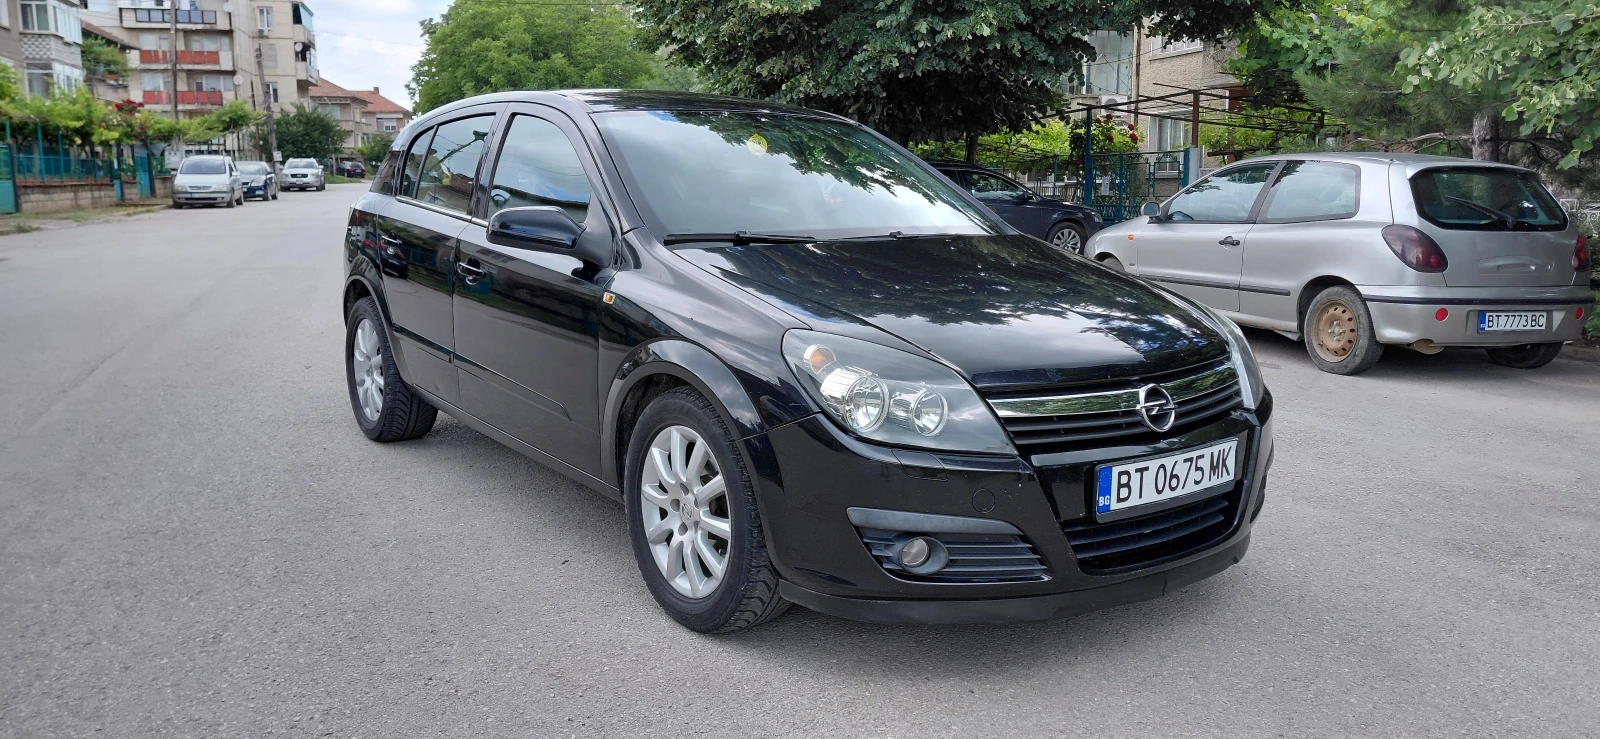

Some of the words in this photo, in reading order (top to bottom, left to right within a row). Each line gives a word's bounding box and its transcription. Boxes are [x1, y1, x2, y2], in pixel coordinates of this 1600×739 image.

[1487, 314, 1502, 328] BT
[1503, 314, 1529, 328] 7773
[1530, 314, 1545, 328] BC
[1116, 466, 1149, 504] BT
[1154, 454, 1205, 495] 0675
[1208, 446, 1233, 482] MK
[1098, 495, 1110, 506] BG
